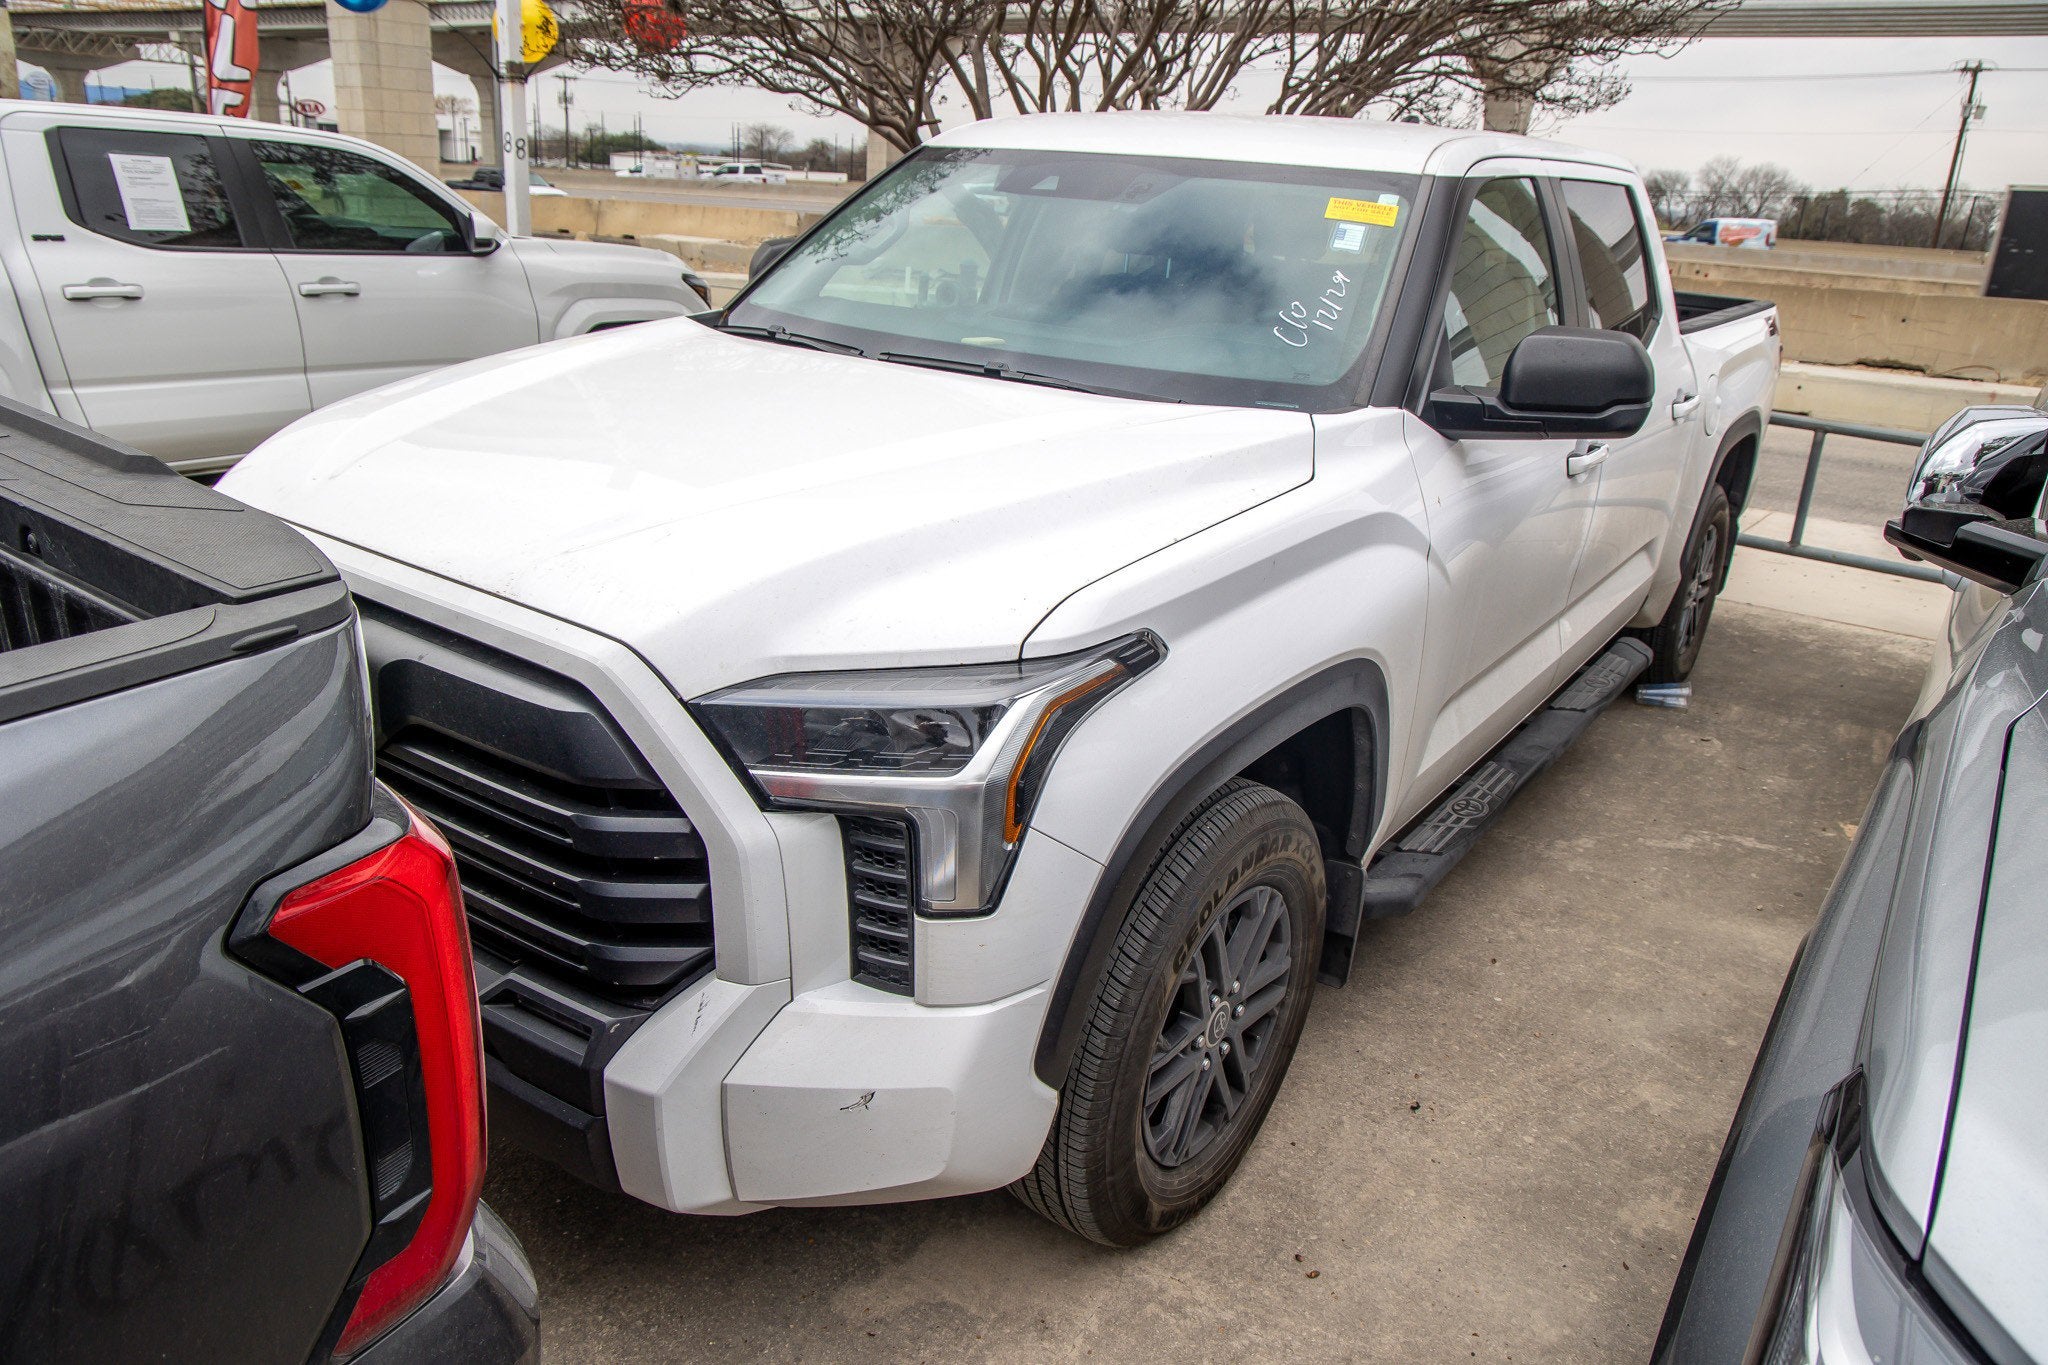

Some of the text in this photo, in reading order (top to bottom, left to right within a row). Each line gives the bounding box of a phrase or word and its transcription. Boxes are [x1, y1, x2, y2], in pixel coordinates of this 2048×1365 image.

[298, 102, 322, 114] KIA
[1333, 199, 1394, 212] THIS VEHICLE
[1172, 833, 1293, 974] GEOLANDAR
